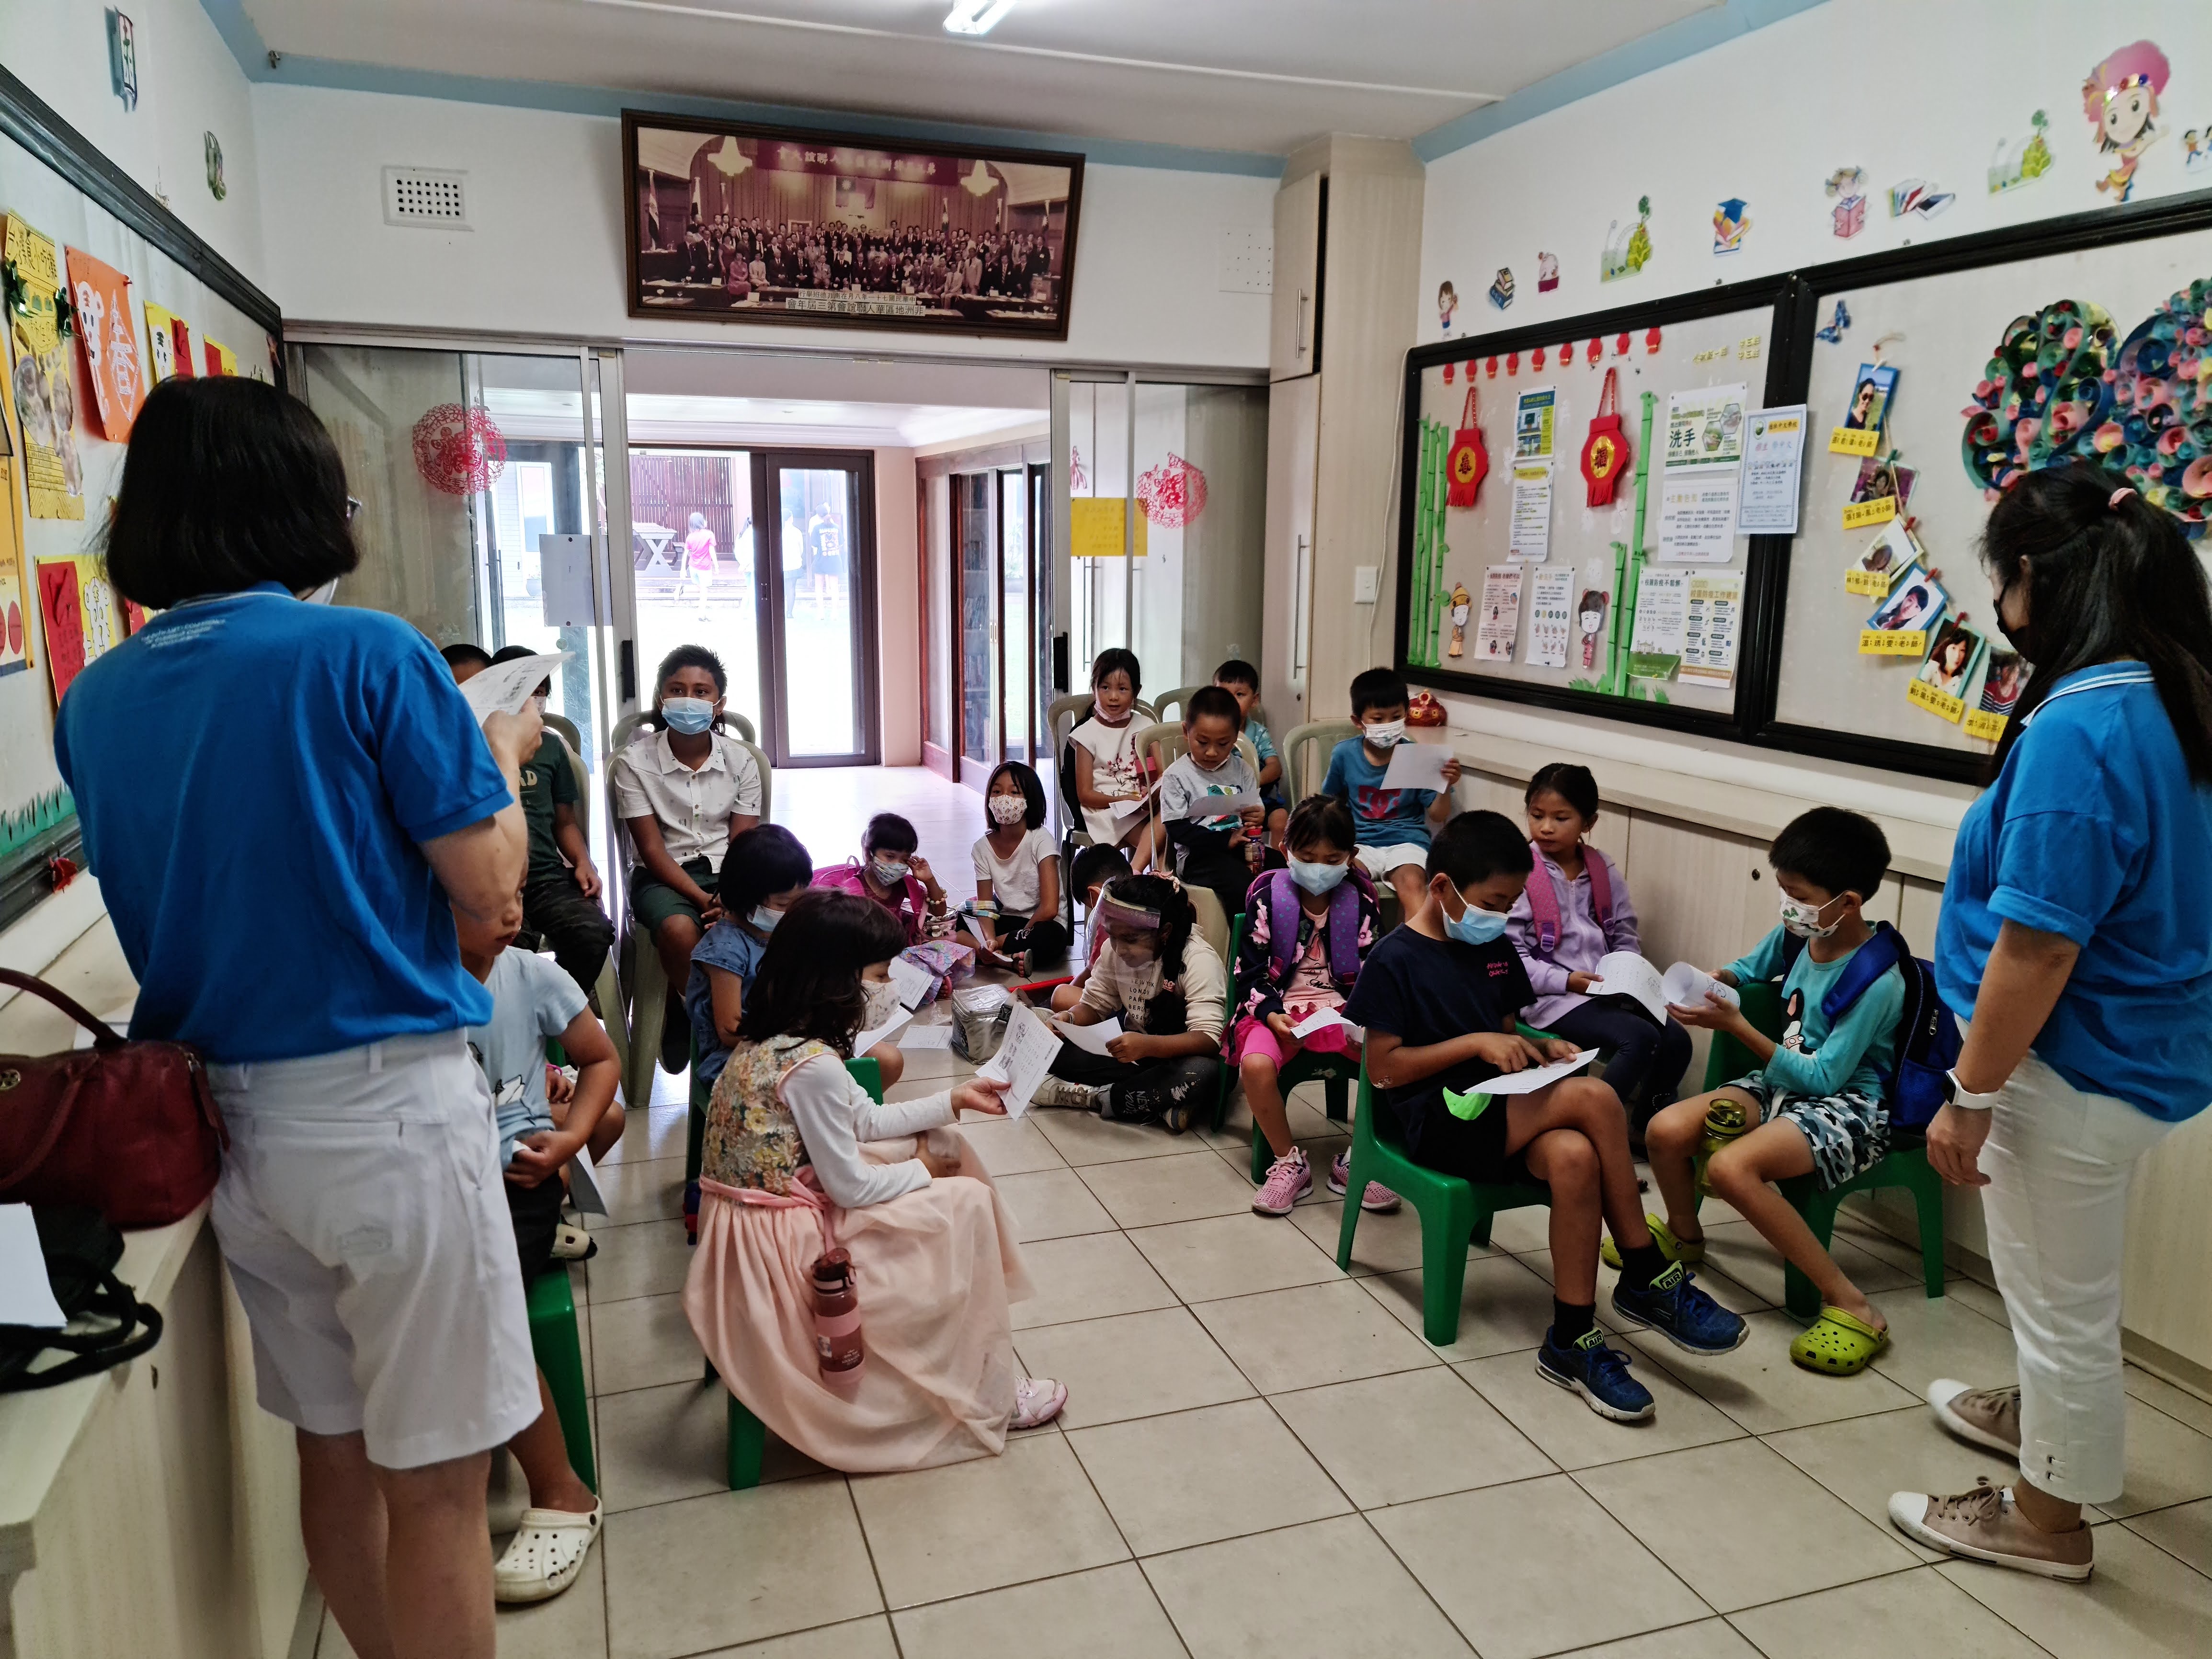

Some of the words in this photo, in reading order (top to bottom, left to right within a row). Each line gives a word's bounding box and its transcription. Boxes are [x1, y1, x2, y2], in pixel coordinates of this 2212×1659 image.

[1669, 427, 1696, 448] 洗手
[1458, 452, 1472, 474] 春
[1594, 446, 1608, 469] 福
[1662, 1272, 1682, 1289] AIR
[1585, 1333, 1604, 1348] AIR
